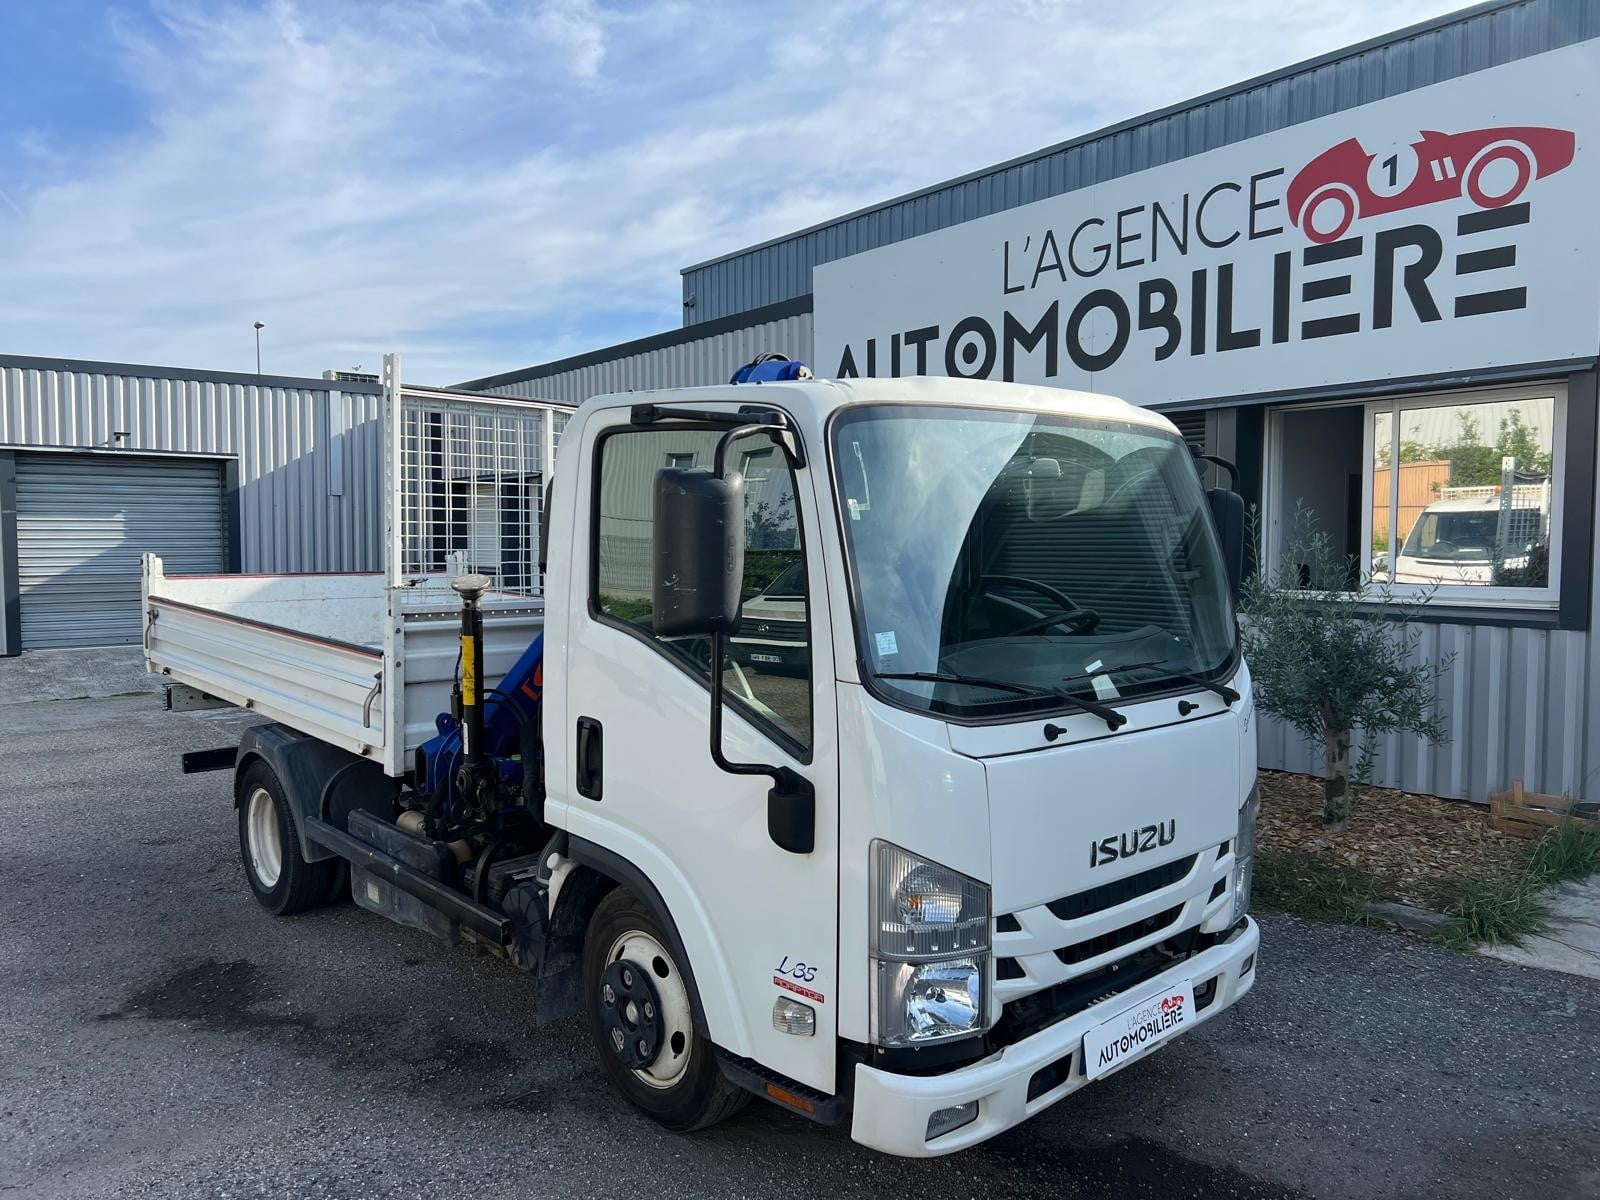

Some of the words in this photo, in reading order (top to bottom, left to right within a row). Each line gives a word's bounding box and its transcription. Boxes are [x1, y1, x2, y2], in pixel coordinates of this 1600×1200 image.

[1003, 168, 1286, 295] L'AGENCE
[837, 202, 1531, 382] AUTOMOBILIERE
[1089, 818, 1175, 869] ISUZU
[774, 956, 818, 982] L35
[1098, 1006, 1184, 1067] AUTOMOBILIERE
[1127, 1002, 1162, 1030] L'AGENCE
